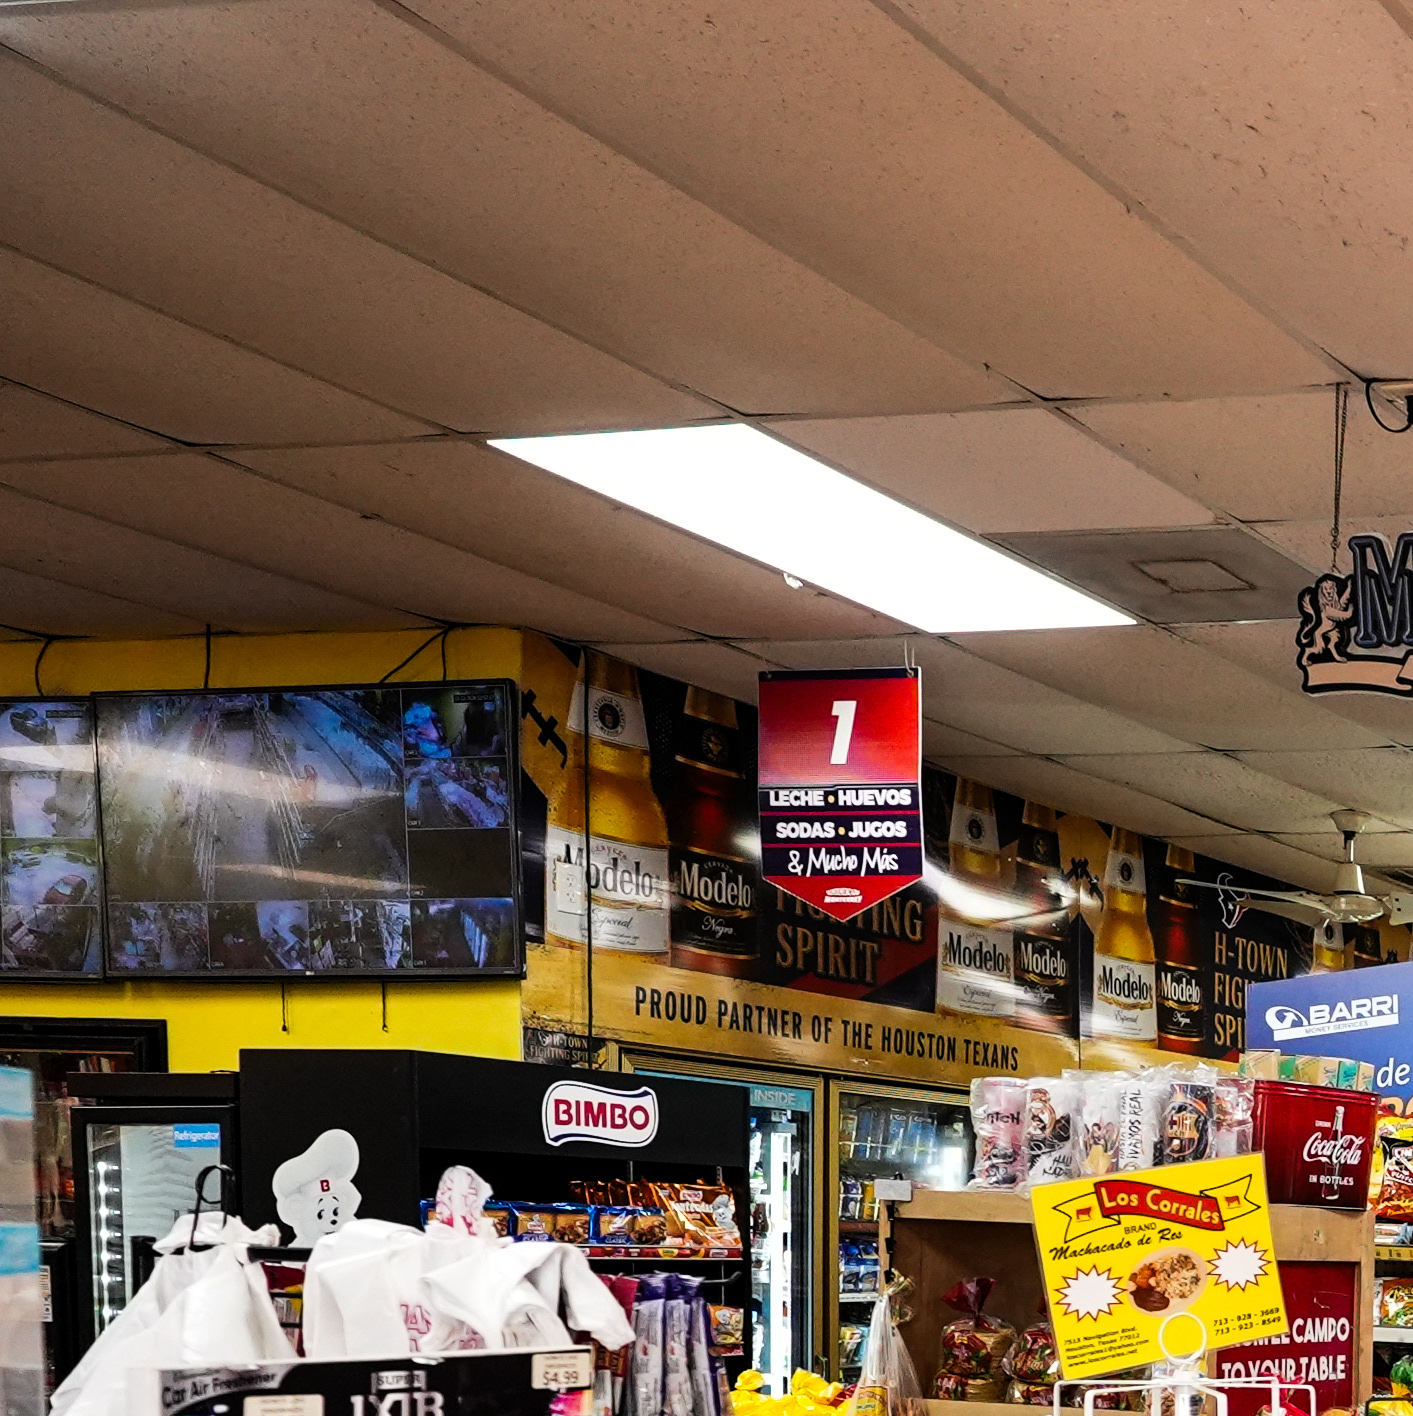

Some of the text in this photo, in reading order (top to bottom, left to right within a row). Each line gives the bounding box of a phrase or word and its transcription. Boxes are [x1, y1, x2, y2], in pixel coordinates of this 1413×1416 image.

[830, 700, 858, 765] 1
[769, 788, 912, 807] LECHE HUEVOS
[776, 821, 908, 839] SODAS JUGOS
[787, 845, 899, 878] & Mucho Más
[679, 858, 751, 908] Modelo
[776, 922, 880, 985] SPIRIT
[948, 931, 1005, 975] Modelo
[1020, 940, 1067, 978] Modelo
[1214, 931, 1288, 979] H-TOWN
[1101, 964, 1149, 1002] Modelo
[1160, 969, 1201, 1005] Modelo
[1309, 993, 1399, 1025] BARRI
[635, 985, 1019, 1072] PROUD PARTNER OF THE HOUSTON TEXANS
[1304, 1019, 1369, 1035] MONEY SERVICES
[1376, 1056, 1411, 1088] de
[752, 1090, 797, 1106] INSIDE
[553, 1098, 651, 1132] BIMBO
[1309, 1173, 1354, 1188] IN BOTTLES
[1100, 1187, 1220, 1225] Los Corrales
[1049, 1228, 1183, 1262] Machacado de Res
[1124, 1222, 1157, 1235] BRAND
[1292, 1316, 1350, 1344] CAMPO
[541, 1370, 580, 1386] $4.99
[1299, 1354, 1347, 1383] TABLE
